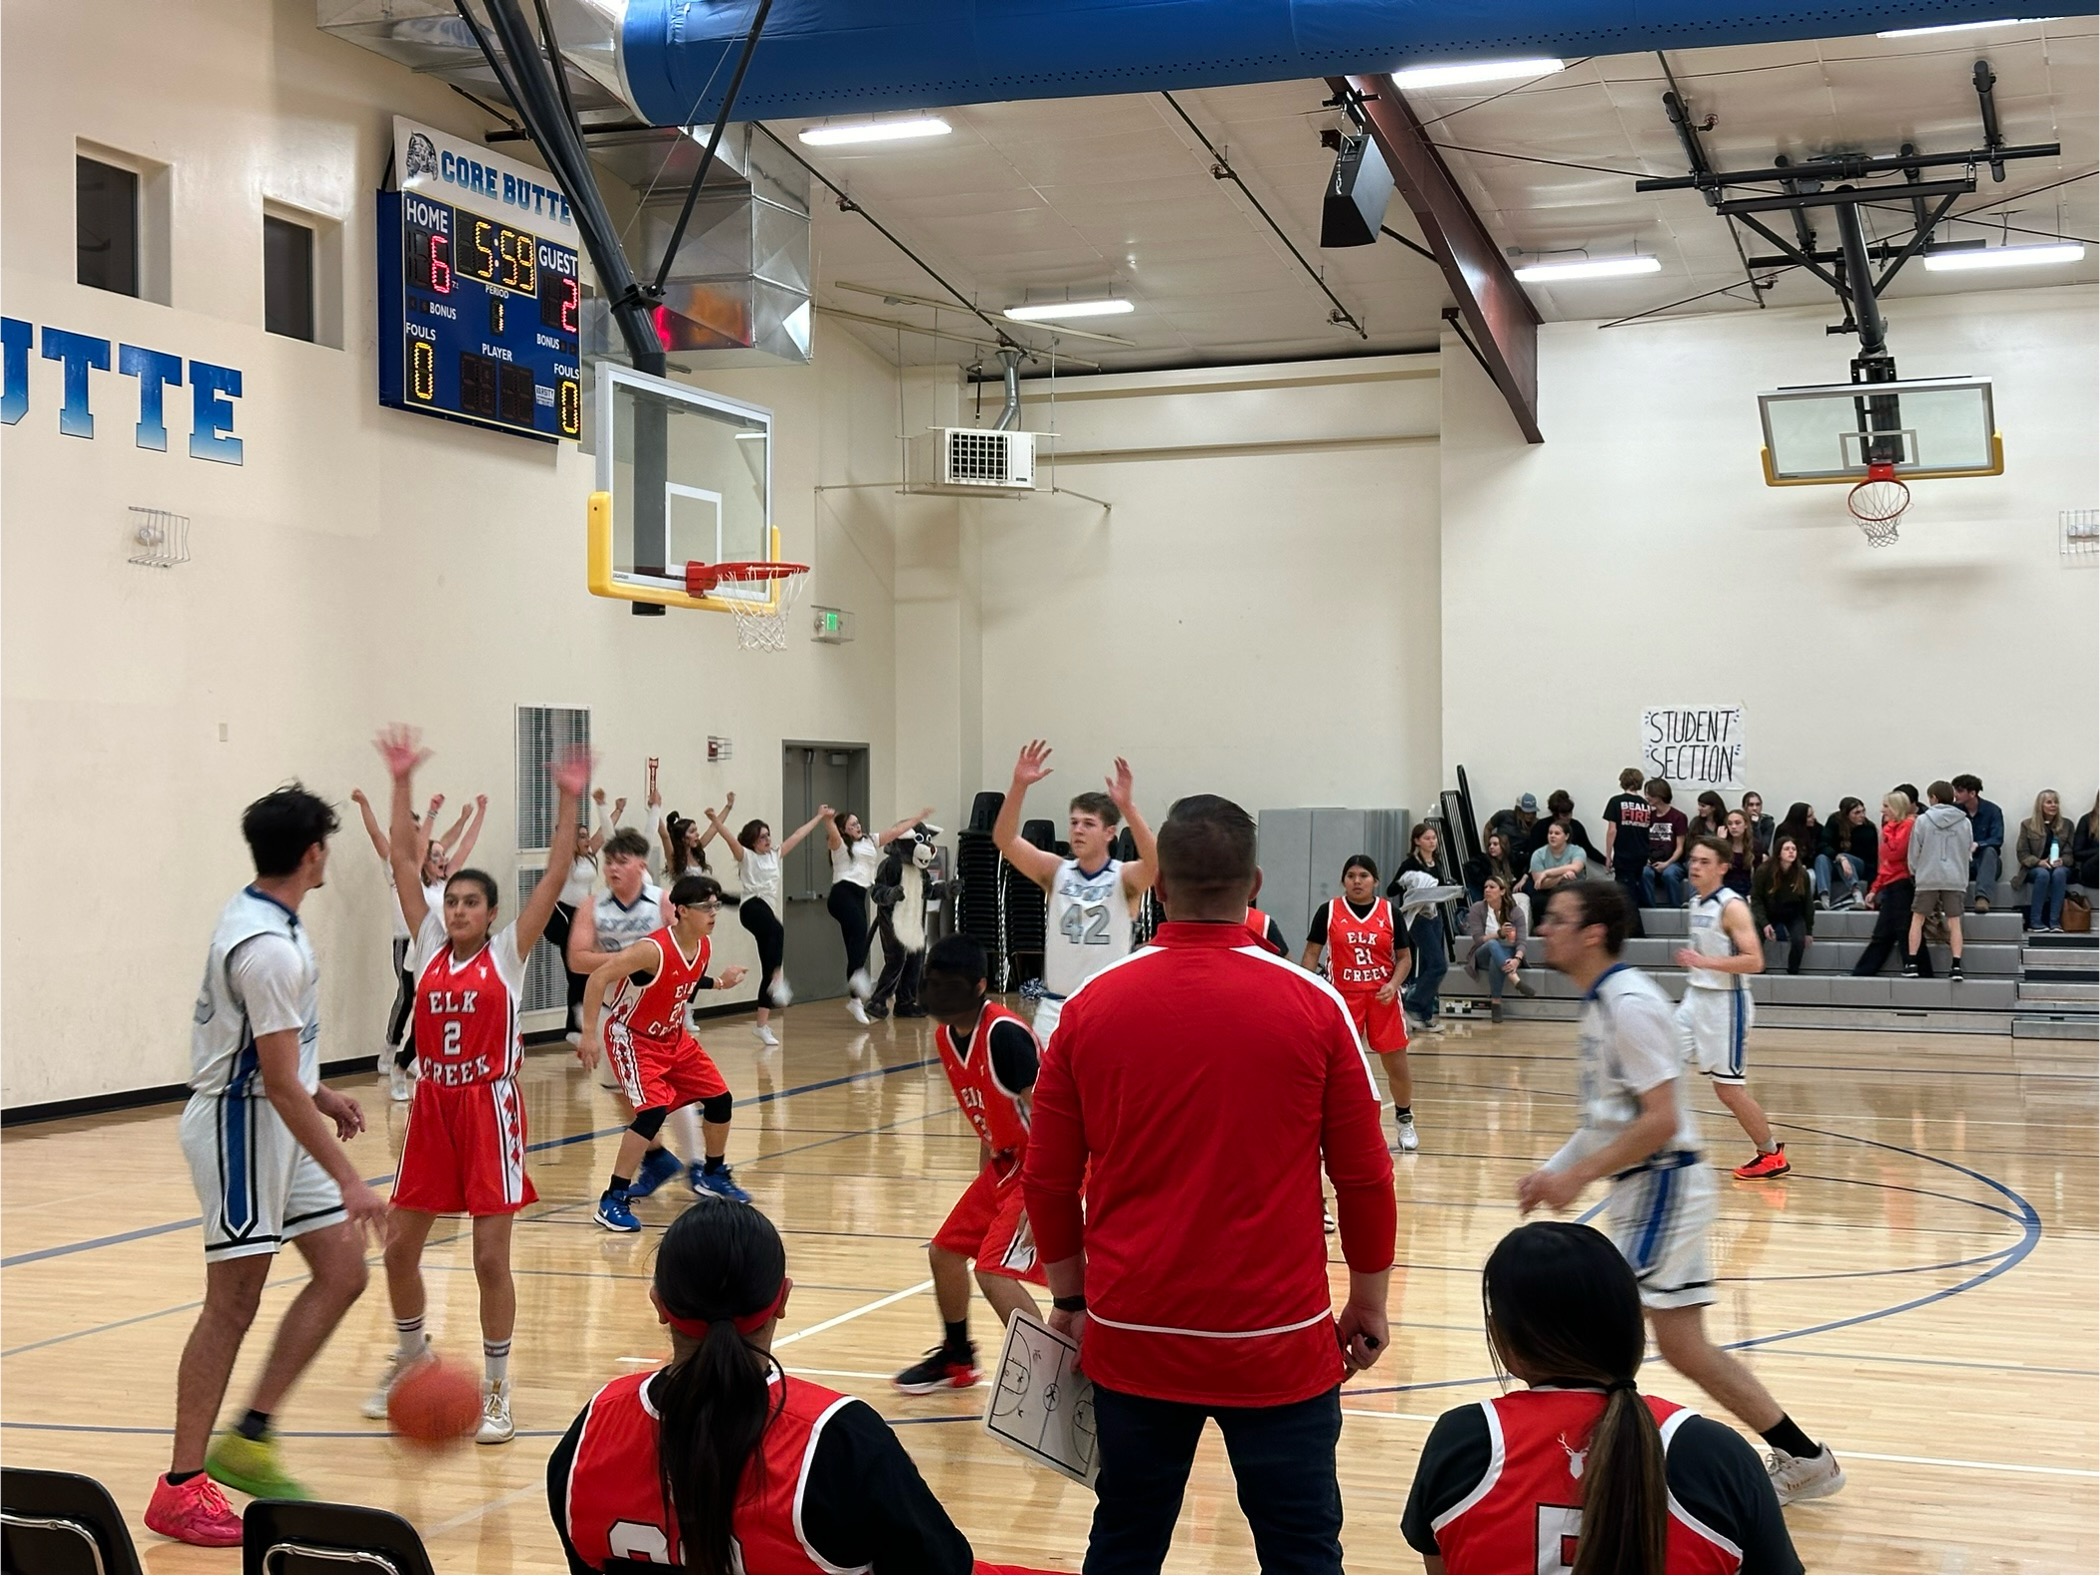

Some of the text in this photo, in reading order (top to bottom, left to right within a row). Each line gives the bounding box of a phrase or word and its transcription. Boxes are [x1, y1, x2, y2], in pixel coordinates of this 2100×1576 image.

[441, 150, 571, 227] CORE BUTTE
[406, 198, 449, 234] HOME
[431, 234, 450, 294] 6
[475, 221, 535, 291] 5:59
[538, 245, 578, 277] GUEST
[485, 284, 510, 300] PERIOD
[560, 277, 579, 334] 2
[429, 302, 457, 320] BONUS
[498, 303, 505, 332] 1
[405, 322, 437, 341] FOULS
[536, 333, 560, 350] BONUS
[482, 343, 513, 362] PLAYER
[413, 341, 434, 400] 0
[553, 363, 580, 380] FOULS
[561, 380, 579, 434] 0
[1650, 710, 1735, 744] STUDENT
[1650, 744, 1734, 784] SECTION
[1621, 809, 1650, 822] FIRE
[1060, 903, 1111, 945] 42
[1346, 931, 1378, 946] ELK
[1354, 947, 1375, 966] 21
[428, 990, 479, 1015] ELK
[443, 1020, 462, 1056] 2
[423, 1054, 491, 1087] CREEK
